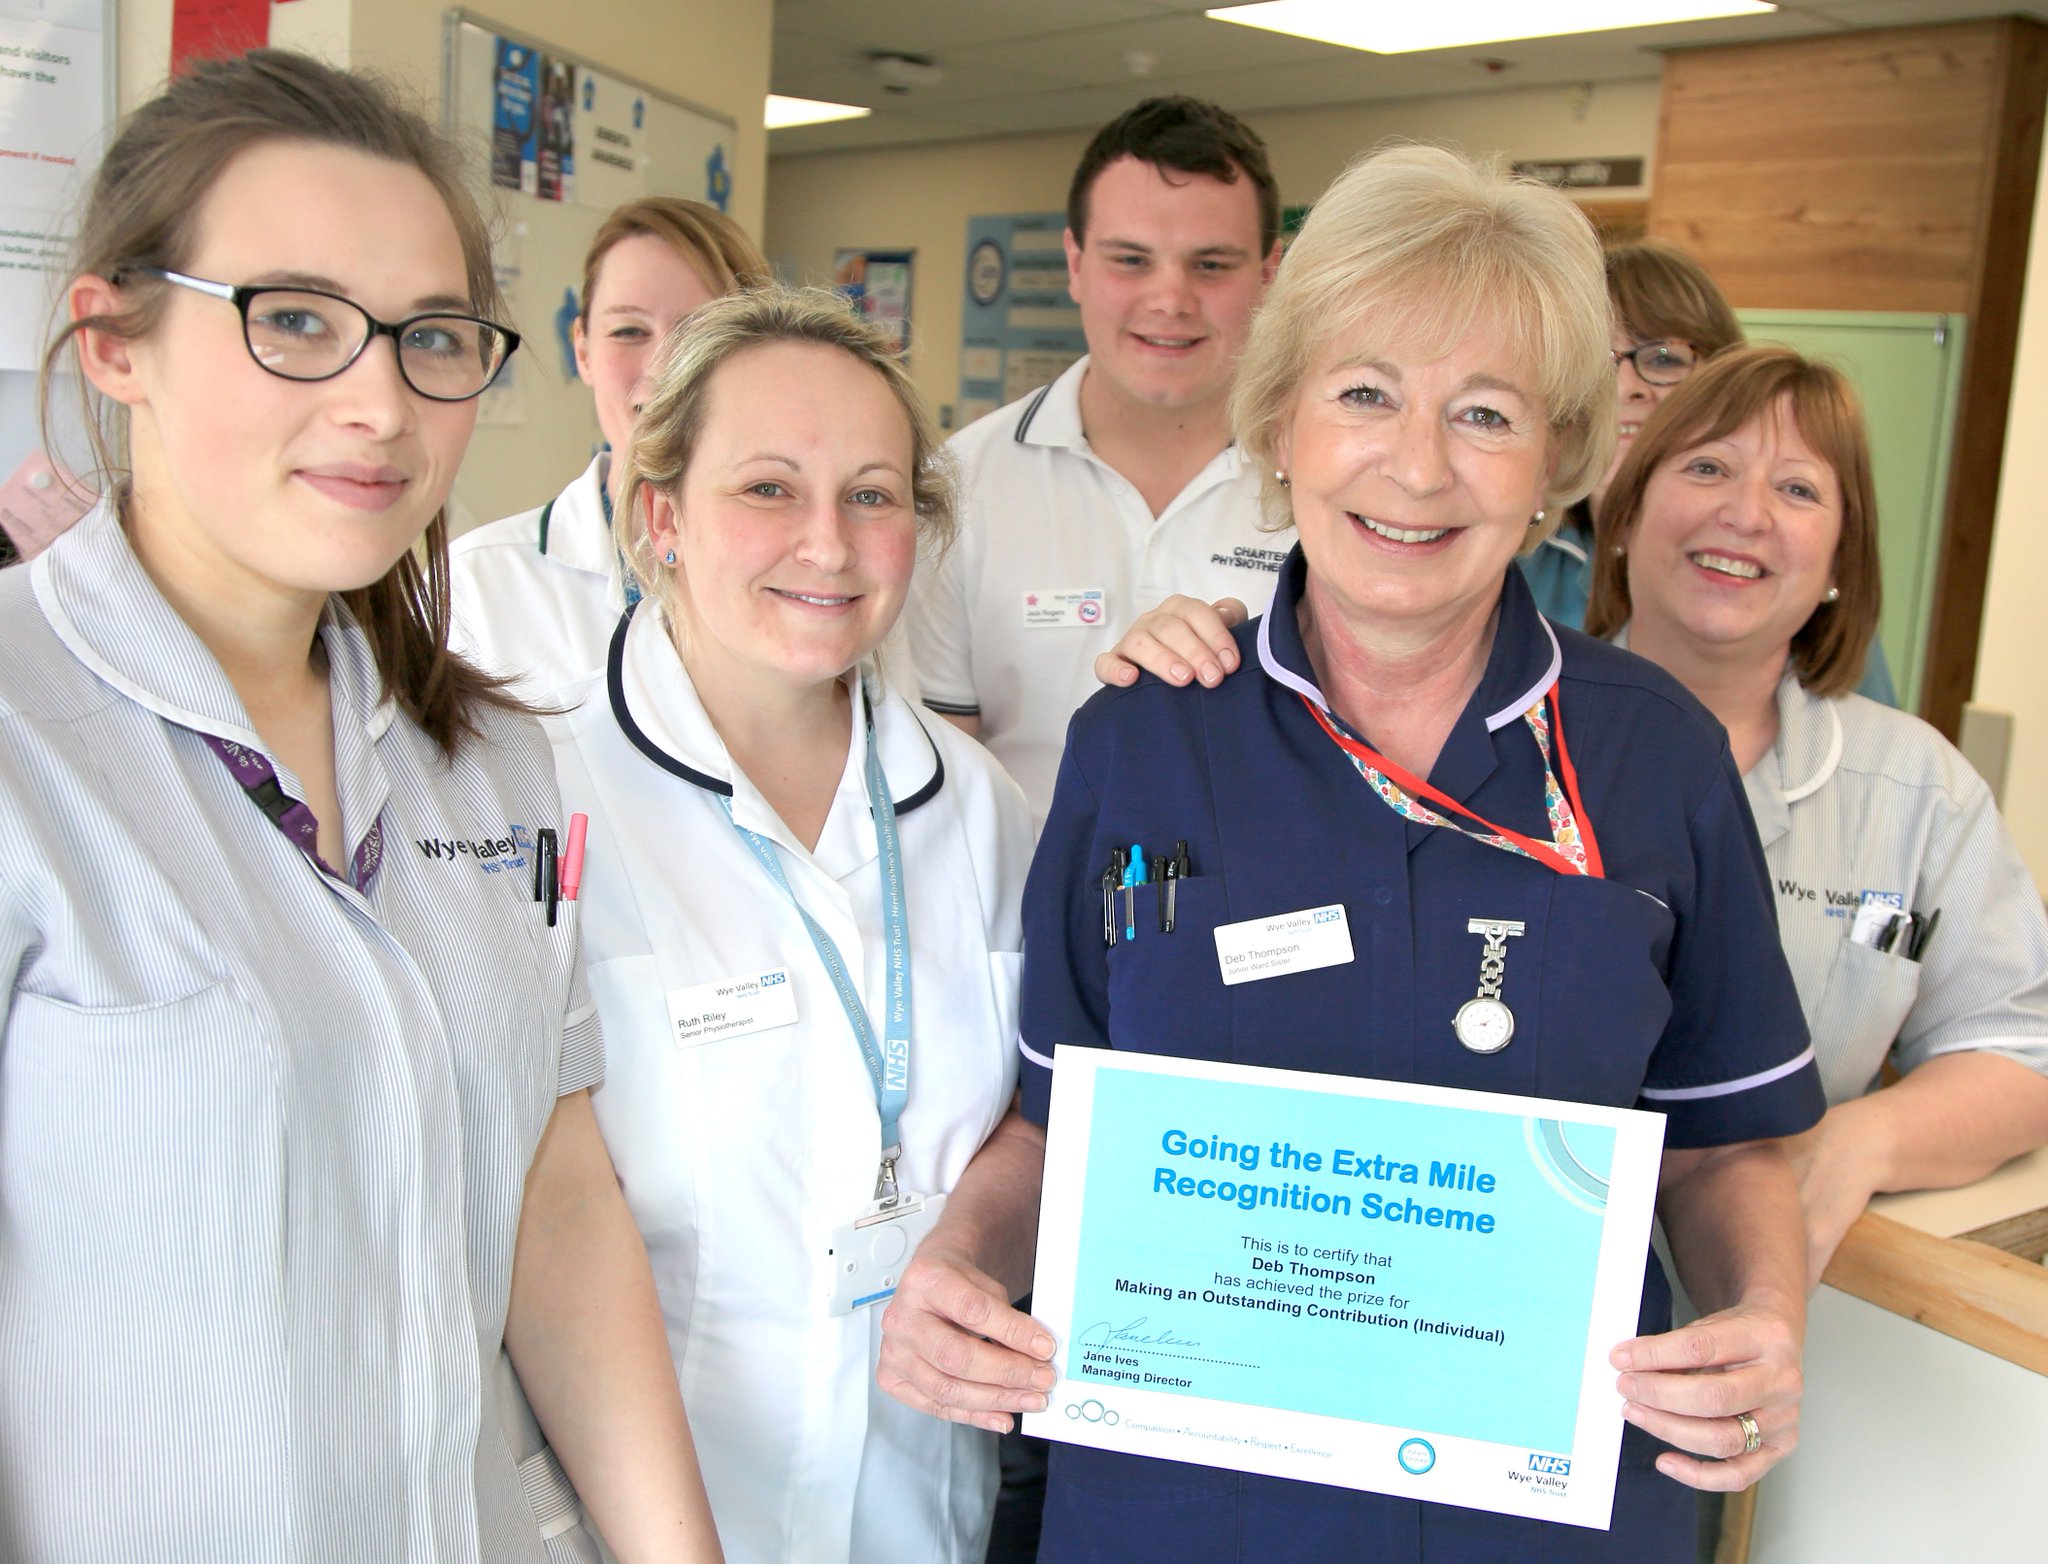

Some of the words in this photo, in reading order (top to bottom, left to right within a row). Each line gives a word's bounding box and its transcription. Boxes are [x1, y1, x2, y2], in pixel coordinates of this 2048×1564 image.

[24, 48, 71, 65] visitors
[35, 71, 56, 84] the
[1211, 553, 1279, 573] PHYSIOTHE
[1234, 546, 1289, 562] CHARTER
[416, 838, 468, 861] Wye
[467, 834, 518, 860] Valley
[882, 825, 893, 851] health
[480, 860, 500, 874] NHS
[500, 856, 527, 871] Trust
[1779, 879, 1817, 901] Wye
[1825, 888, 1860, 906] Valle
[1861, 889, 1904, 911] NHS
[1266, 922, 1285, 932] Wye
[1286, 918, 1311, 929] Valley
[1313, 909, 1341, 925] NHS
[893, 924, 902, 947] Trust
[893, 949, 903, 969] NHS
[1225, 953, 1246, 965] Deb
[1248, 943, 1300, 961] Thompson
[1228, 966, 1249, 976] Junior
[1250, 961, 1269, 971] Ward
[1271, 957, 1291, 967] Sister
[716, 987, 734, 997] Wye
[735, 981, 759, 993] Valley
[760, 972, 786, 988] NHS
[894, 970, 905, 999] Valley
[677, 1017, 701, 1029] Ruth
[702, 1012, 727, 1024] Riley
[894, 1000, 905, 1022] Wye
[680, 1029, 702, 1039] Senior
[703, 1017, 754, 1034] Physiotherapist
[859, 1020, 873, 1055] service
[886, 1039, 909, 1090] NHS
[1161, 1129, 1260, 1171] Going
[1269, 1142, 1323, 1172] the
[1332, 1149, 1419, 1185] Extra
[1428, 1160, 1497, 1194] Mile
[1153, 1166, 1351, 1216] Recognition
[1361, 1192, 1496, 1234] Scheme
[1241, 1235, 1272, 1252] This
[1277, 1240, 1290, 1255] is
[1294, 1243, 1308, 1257] to
[1313, 1248, 1359, 1266] certify
[1364, 1252, 1393, 1268] that
[1252, 1257, 1284, 1273] Deb
[1289, 1261, 1376, 1285] Thompson
[1214, 1272, 1241, 1288] has
[1246, 1277, 1314, 1297] achieved
[1319, 1286, 1343, 1301] the
[1347, 1291, 1385, 1306] prize
[1389, 1294, 1410, 1310] for
[1115, 1278, 1172, 1301] Making
[1178, 1289, 1197, 1301] an
[1202, 1289, 1302, 1318] Outstanding
[1306, 1303, 1408, 1330] Contribution
[1413, 1317, 1506, 1347] (Individual)
[1083, 1350, 1112, 1364] Jane
[1115, 1354, 1140, 1367] Ives
[1081, 1364, 1140, 1384] Managing
[1144, 1372, 1193, 1389] Director
[1124, 1418, 1175, 1435] Compassion
[1182, 1426, 1243, 1446] Accountability
[1250, 1436, 1282, 1452] Respect
[1290, 1442, 1333, 1459] Excellence
[1529, 1454, 1571, 1476] NHS
[1508, 1470, 1532, 1484] Wye
[1535, 1475, 1568, 1490] Valley
[1530, 1486, 1547, 1496] NHS
[1549, 1489, 1568, 1499] Trust
